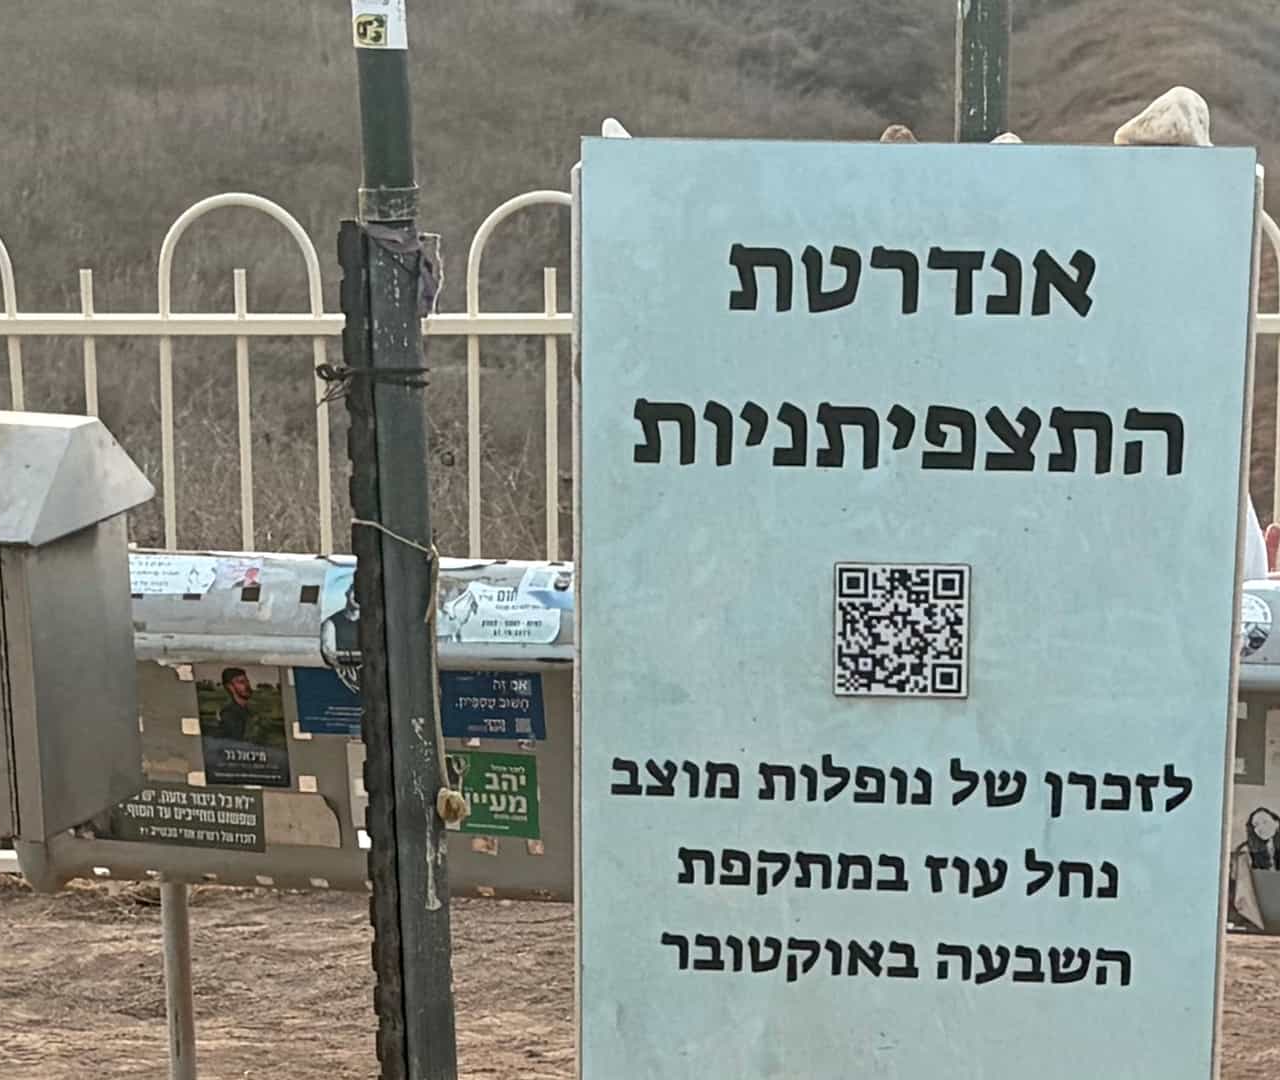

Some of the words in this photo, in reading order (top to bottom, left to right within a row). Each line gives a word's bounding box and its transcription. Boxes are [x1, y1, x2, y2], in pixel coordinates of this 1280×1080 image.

[728, 243, 1096, 318] אנדרטת
[633, 397, 1185, 476] התצפיתניות
[484, 771, 527, 791] יהב
[610, 757, 740, 800] מוצב
[757, 753, 933, 806] נופלות
[949, 757, 1027, 808] של
[1044, 763, 1193, 819] לזכרון
[677, 846, 909, 896] במתקפת
[924, 854, 1008, 899] עוז
[1024, 847, 1119, 899] נחל
[660, 931, 919, 983] באוקטובר
[936, 942, 1132, 987] השבעה
